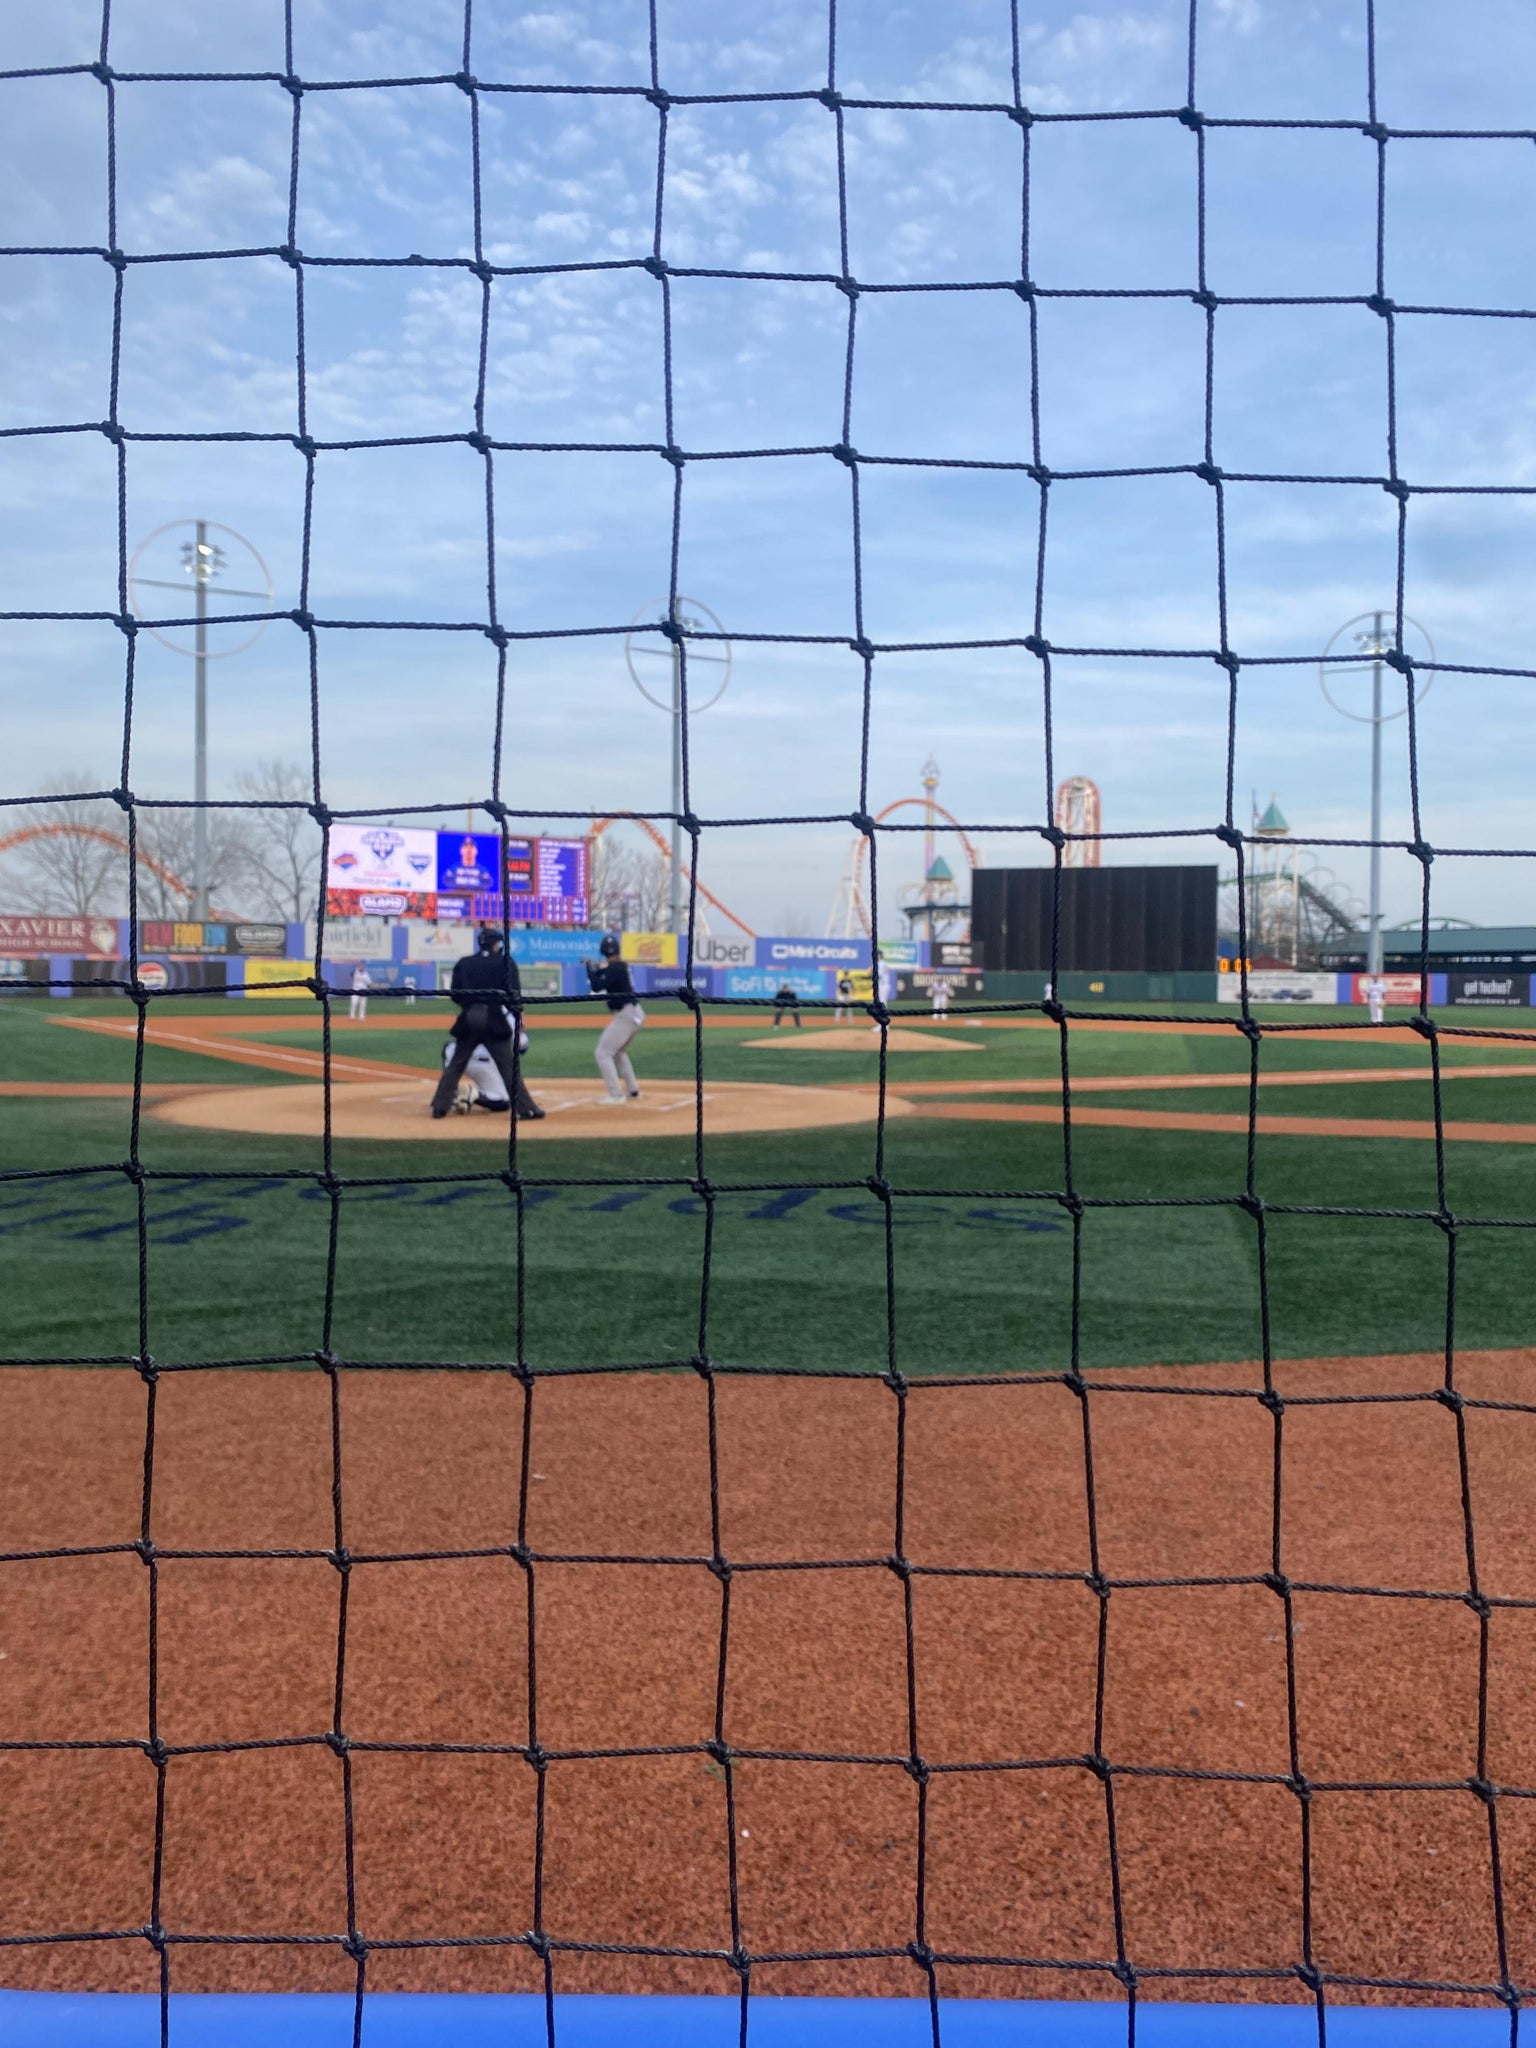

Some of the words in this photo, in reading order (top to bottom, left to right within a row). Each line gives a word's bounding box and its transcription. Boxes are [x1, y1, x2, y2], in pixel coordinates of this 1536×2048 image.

[0, 919, 86, 937] XAVIER
[315, 928, 382, 943] airfield
[35, 938, 83, 950] SCHOOL
[529, 936, 600, 950] Maimonides
[695, 940, 751, 961] Uber
[788, 945, 858, 959] Mini-Circuits
[731, 975, 761, 993] SoFi
[1464, 980, 1477, 997] got
